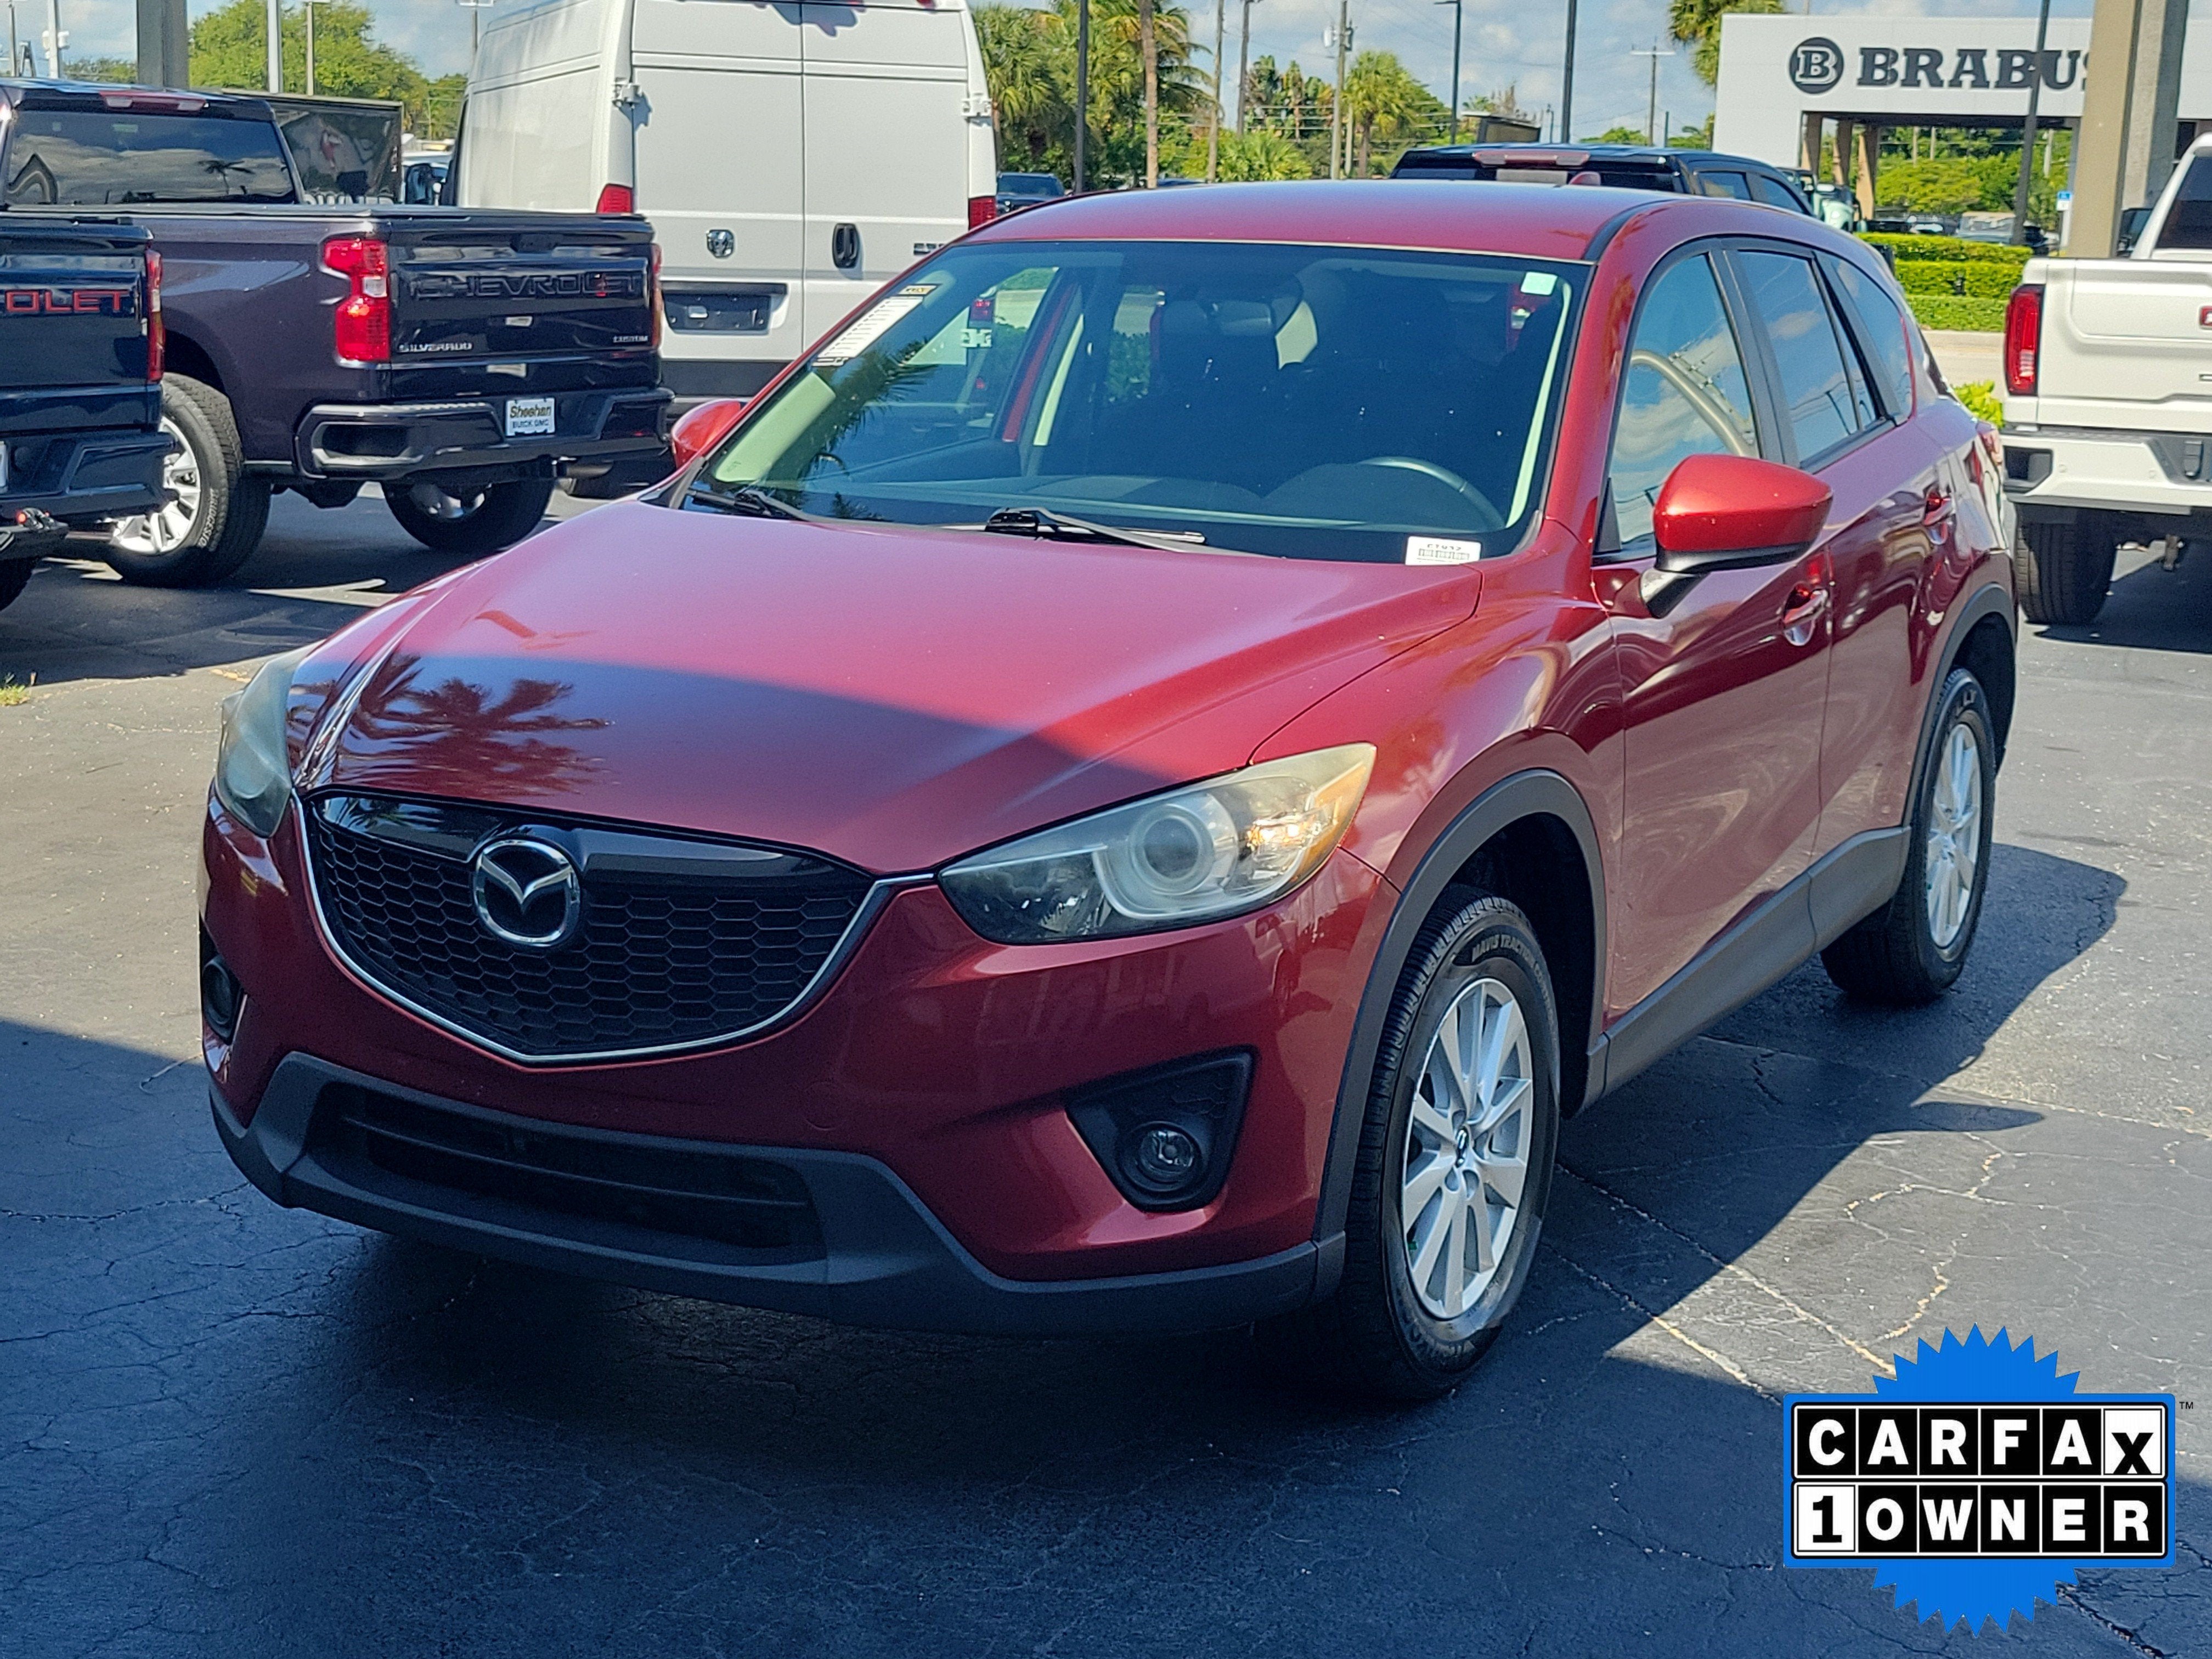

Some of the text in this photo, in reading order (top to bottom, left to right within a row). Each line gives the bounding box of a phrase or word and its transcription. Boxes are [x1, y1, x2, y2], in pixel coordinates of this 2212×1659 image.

[1857, 47, 2089, 91] BRABU
[410, 274, 641, 299] CHEVROLET
[5, 290, 129, 312] OLET
[399, 342, 472, 353] SILVERADO
[510, 404, 551, 418] Sheehan
